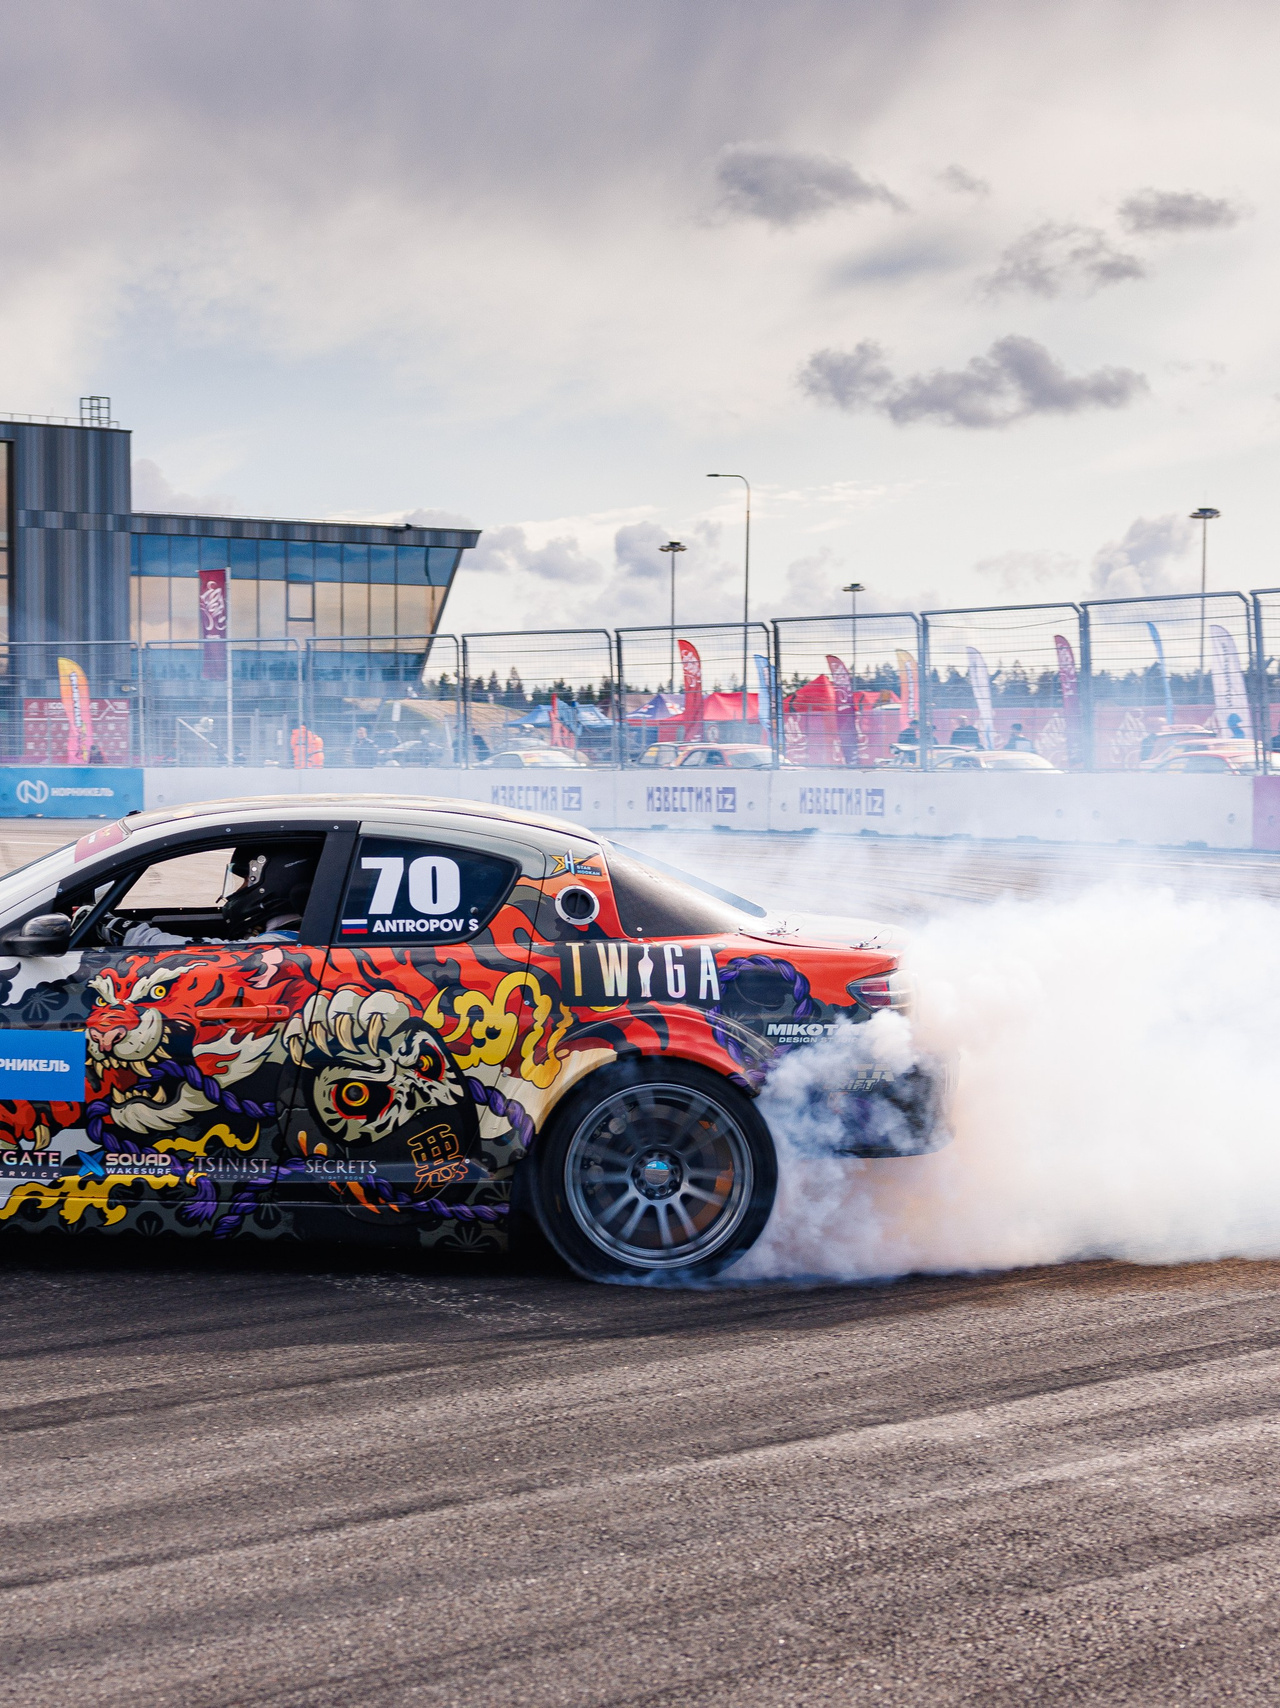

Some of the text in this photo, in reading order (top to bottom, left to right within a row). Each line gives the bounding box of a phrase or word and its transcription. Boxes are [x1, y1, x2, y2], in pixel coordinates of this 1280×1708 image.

[491, 786, 557, 811] ИЗВЕСТИЯ
[646, 787, 712, 813] ИЗВЕСТИЯ
[800, 788, 862, 815] ИЗВЕСТИЯ
[361, 855, 461, 915] 70
[372, 918, 479, 933] ANTROPOV S
[105, 1153, 171, 1167] SQUAD
[305, 1159, 377, 1174] SECRETS
[106, 1167, 171, 1175] WAKESURF
